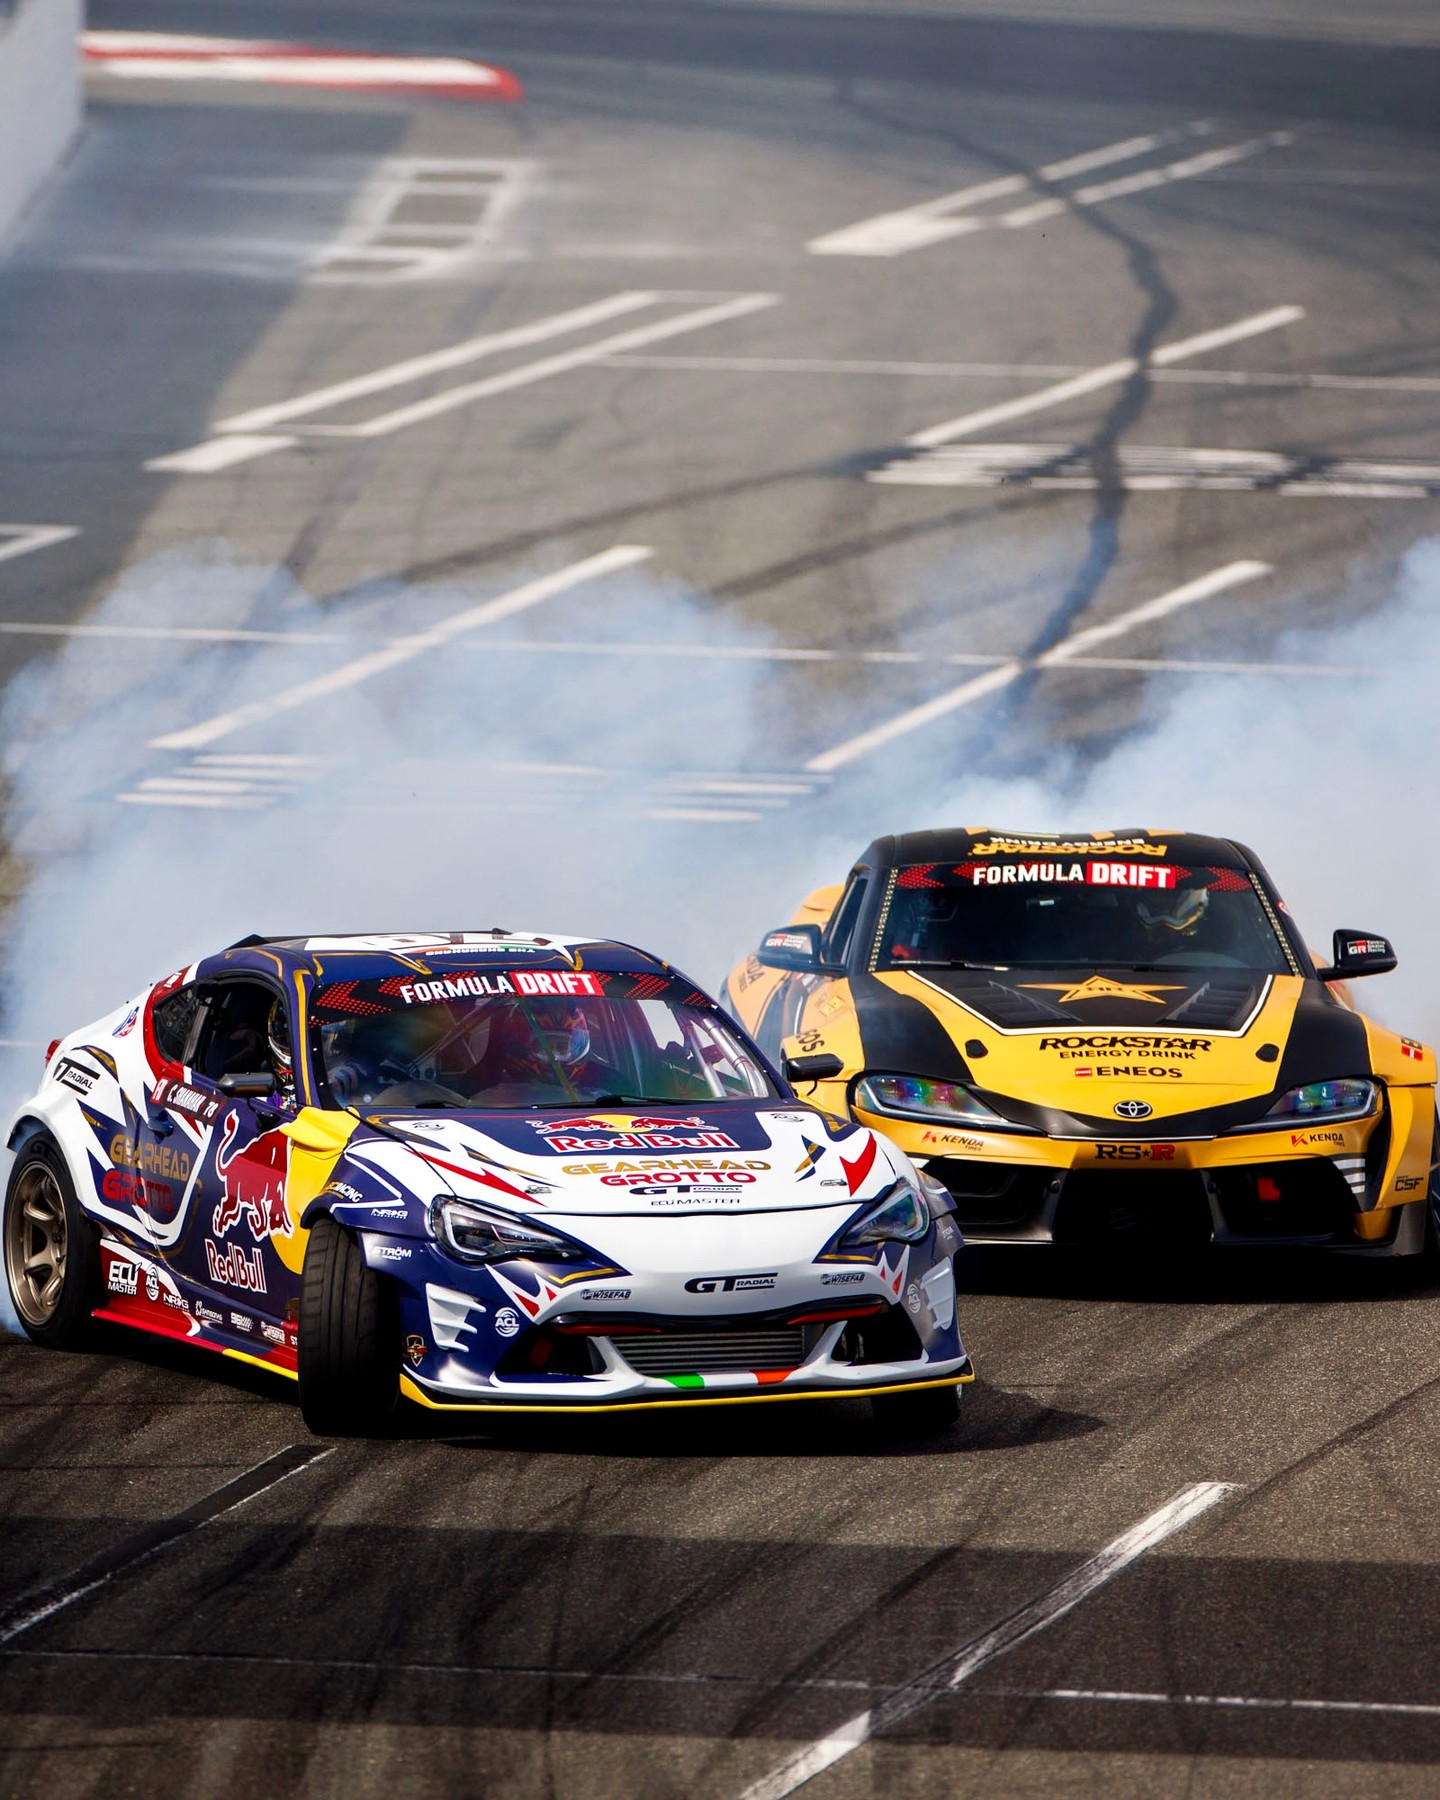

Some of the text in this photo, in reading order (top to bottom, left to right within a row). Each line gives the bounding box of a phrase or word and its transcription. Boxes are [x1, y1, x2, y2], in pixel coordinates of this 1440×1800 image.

[973, 863, 1171, 888] FORMULA DRIFT
[1349, 946, 1367, 955] GR
[400, 973, 595, 1004] FORMULA DRIFT
[1039, 1036, 1212, 1051] ROCKSTAR
[1059, 1050, 1197, 1060] ENERGY DRINK
[1096, 1066, 1183, 1078] ENEOS
[203, 1101, 219, 1117] 78
[546, 1132, 738, 1152] Red Bull
[941, 1134, 984, 1147] KENDA
[1309, 1132, 1344, 1143] KENDA
[110, 1133, 190, 1181] GEARHEAD
[561, 1159, 772, 1176] GEARHEAD
[600, 1172, 757, 1187] GROTTO
[1395, 1177, 1424, 1191] CSF
[102, 1169, 173, 1215] GROTTO
[109, 1260, 139, 1284] ECU
[205, 1238, 268, 1294] Red Bull
[108, 1281, 137, 1296] MASTER
[736, 1278, 777, 1287] RADIAL
